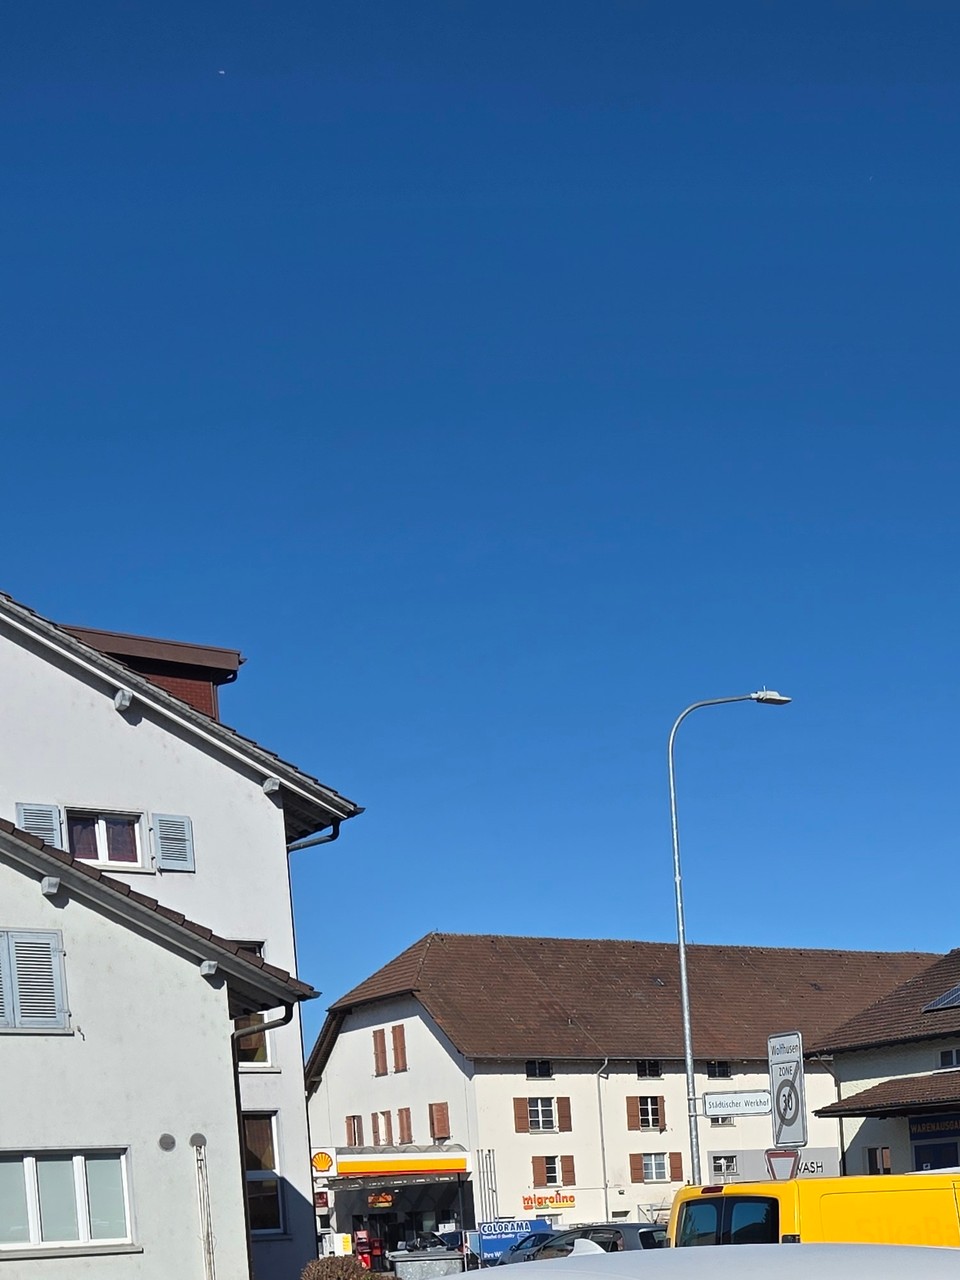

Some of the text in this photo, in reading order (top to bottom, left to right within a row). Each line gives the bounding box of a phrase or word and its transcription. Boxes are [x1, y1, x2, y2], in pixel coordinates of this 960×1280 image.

[779, 1066, 793, 1077] ZONE
[708, 1097, 770, 1109] Städtischer Werkhof
[782, 1093, 793, 1112] 30
[522, 1190, 576, 1207] migrolino
[480, 1221, 532, 1235] COLORAMA
